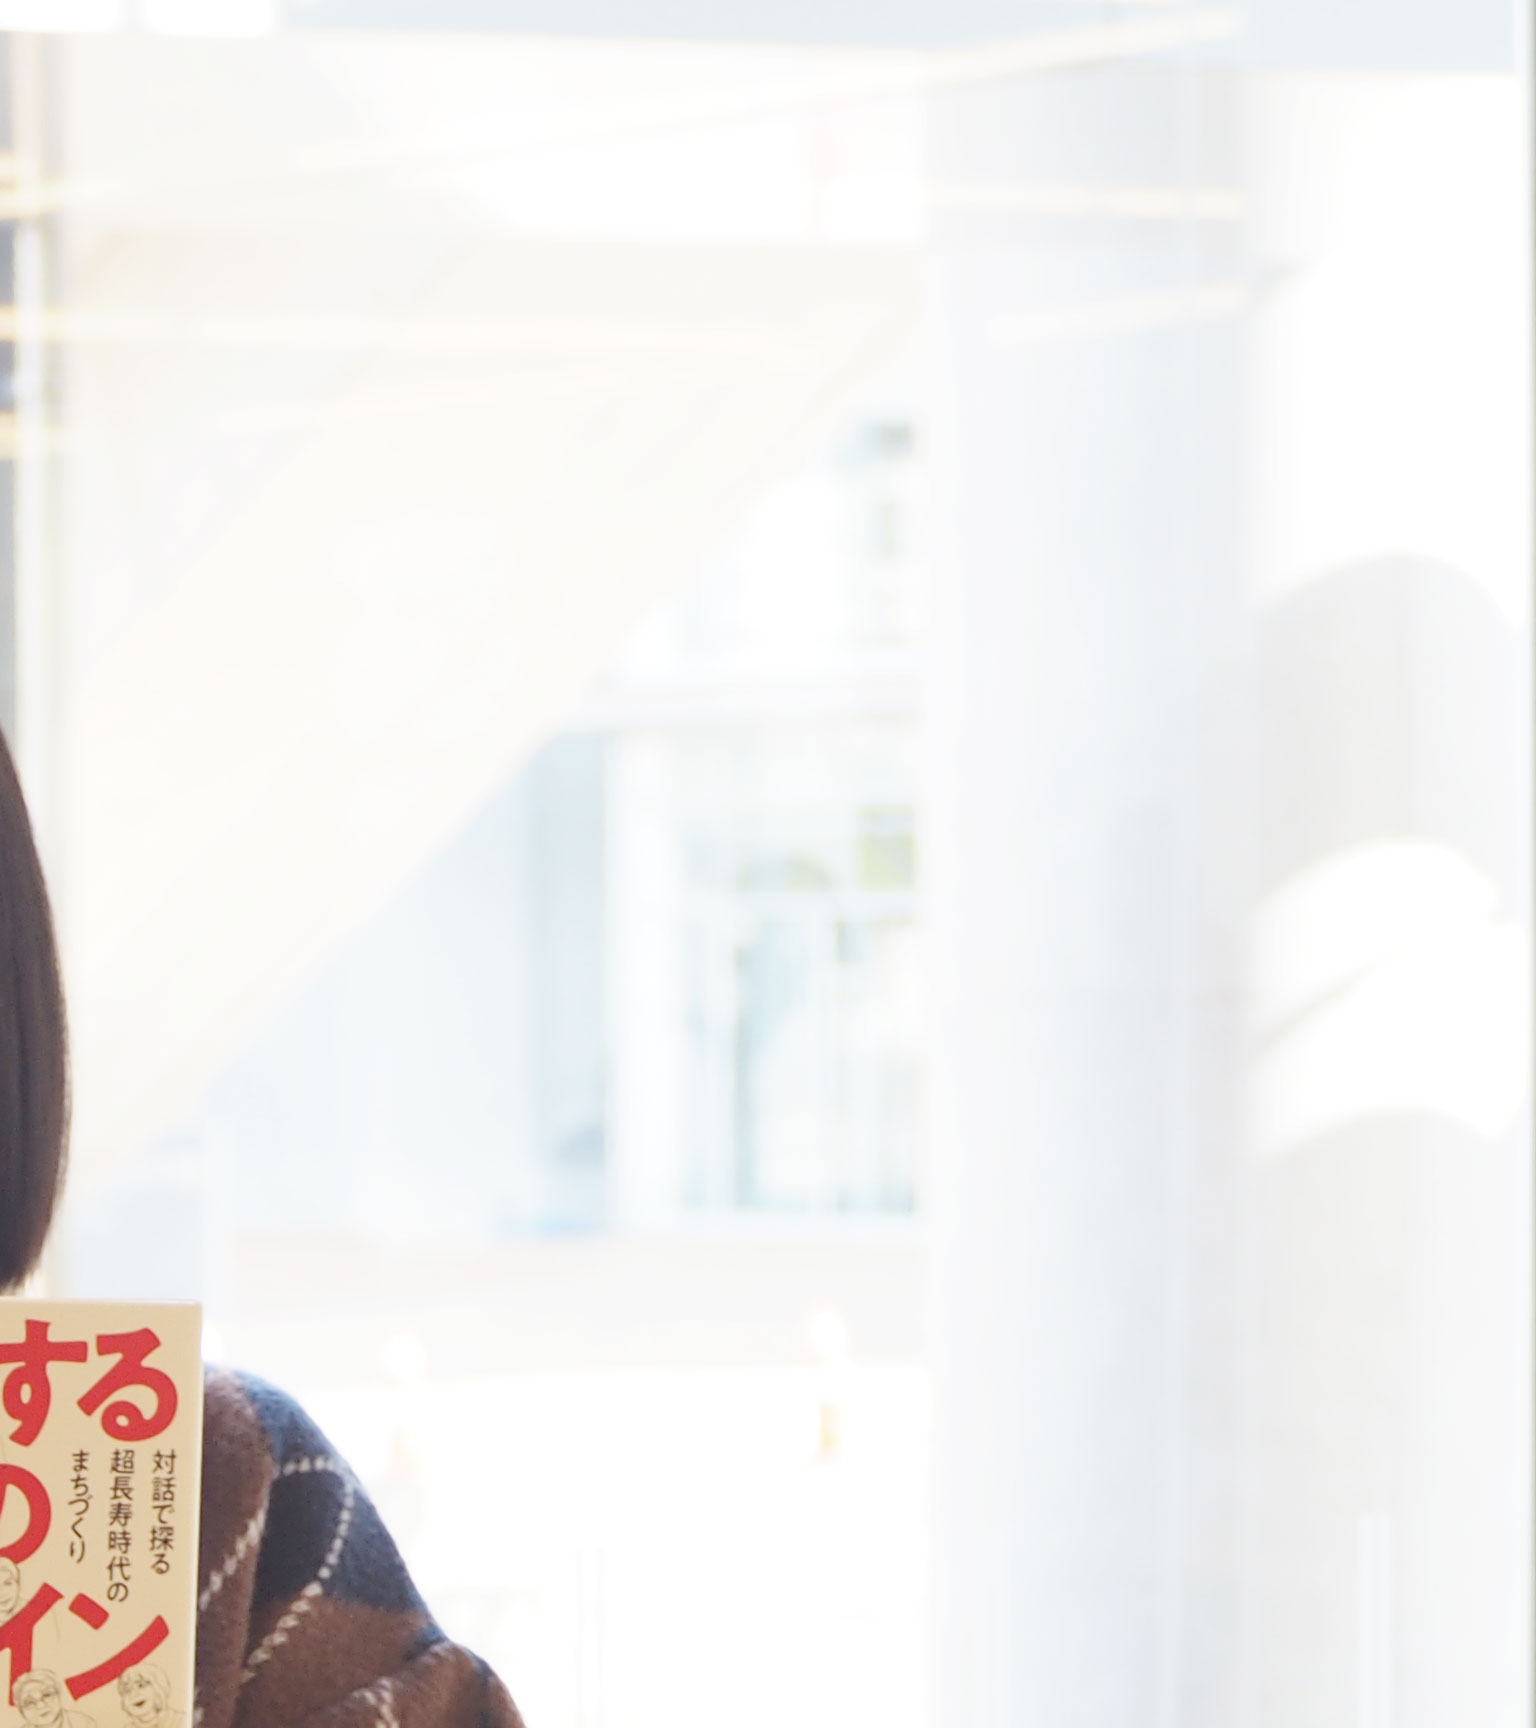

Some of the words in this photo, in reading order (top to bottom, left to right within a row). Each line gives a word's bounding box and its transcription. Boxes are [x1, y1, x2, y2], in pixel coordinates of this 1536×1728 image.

[68, 1450, 91, 1564] まちづくり
[106, 1448, 136, 1603] 超長寿時代の
[149, 1449, 177, 1575] 対話で探る
